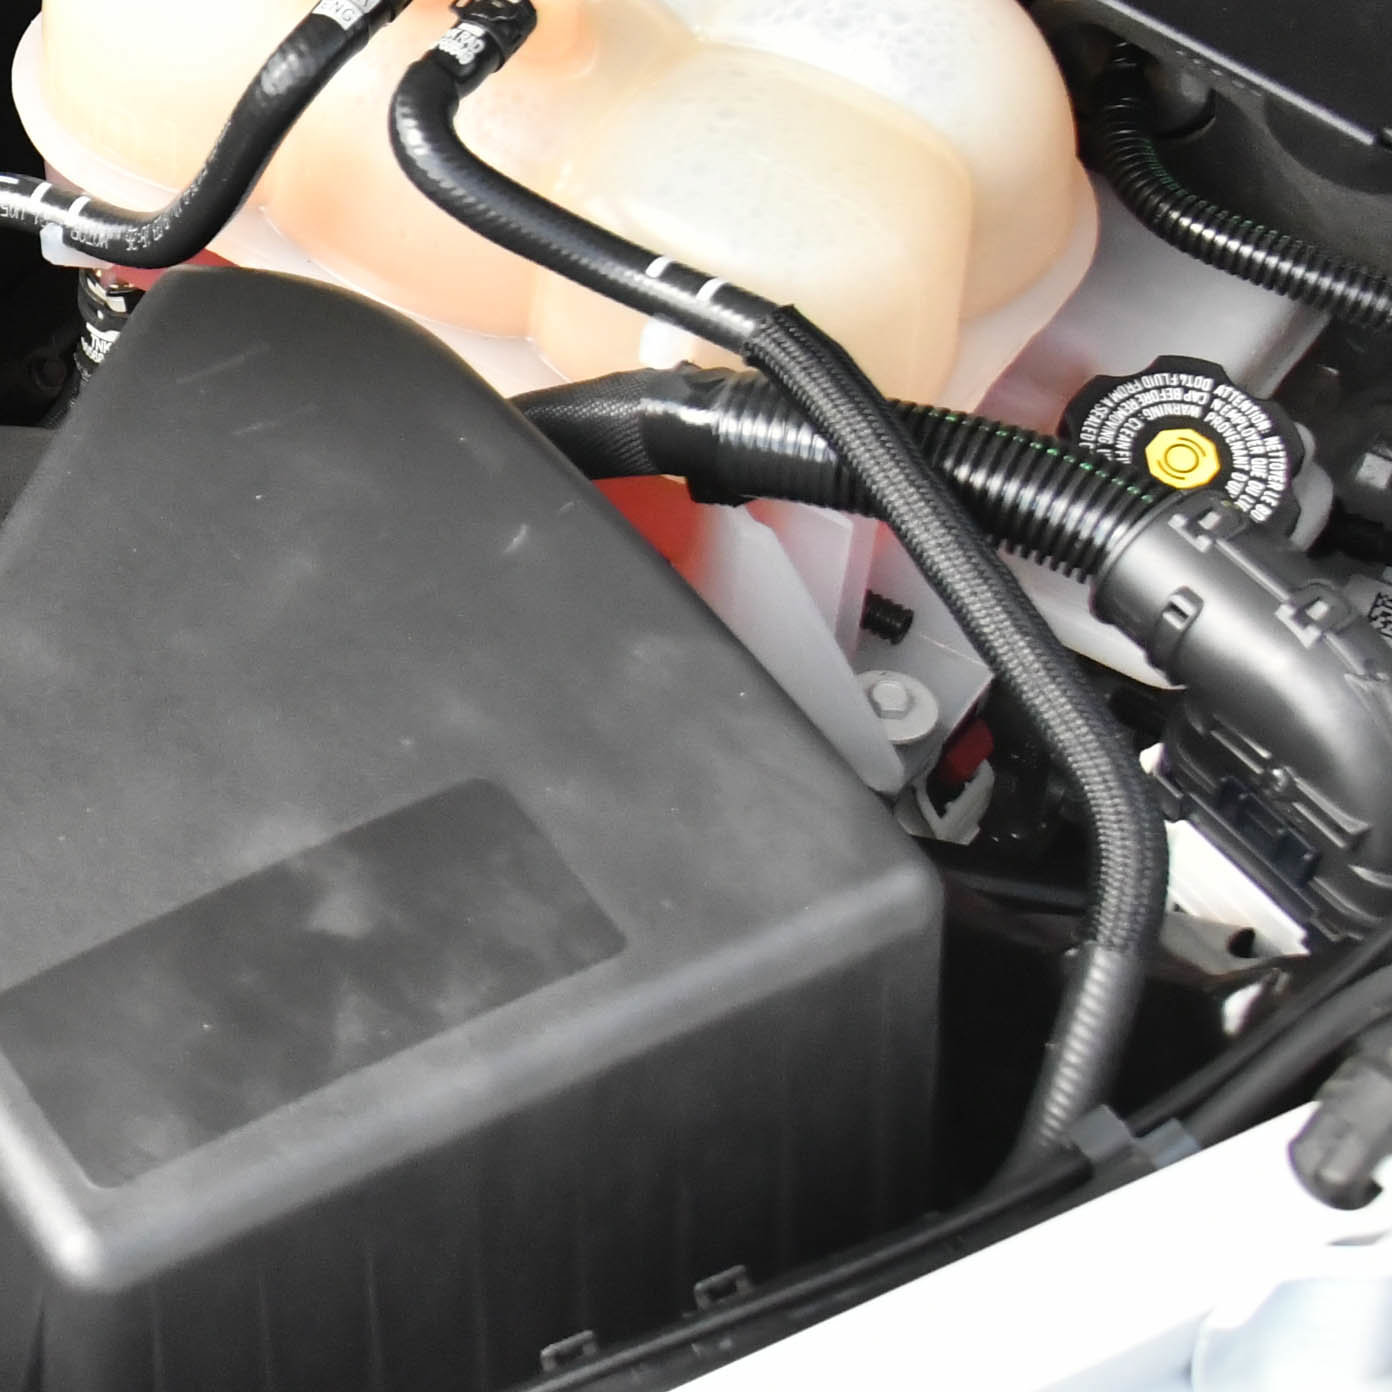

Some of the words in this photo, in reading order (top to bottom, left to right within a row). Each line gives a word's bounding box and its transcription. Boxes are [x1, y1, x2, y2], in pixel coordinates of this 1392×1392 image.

[1108, 378, 1144, 403] FROM
[1140, 373, 1180, 389] FLUID
[1099, 396, 1116, 408] A
[1134, 387, 1184, 408] BEFORE
[1183, 388, 1210, 406] CAP
[1079, 403, 1111, 442] SEALED
[1115, 417, 1145, 450] CLEAN
[1203, 411, 1251, 471] PROVENANT
[1249, 456, 1268, 479] QUE
[1263, 435, 1288, 492] NETTOYER
[1244, 479, 1266, 497] DU
[1260, 490, 1281, 507] LE
